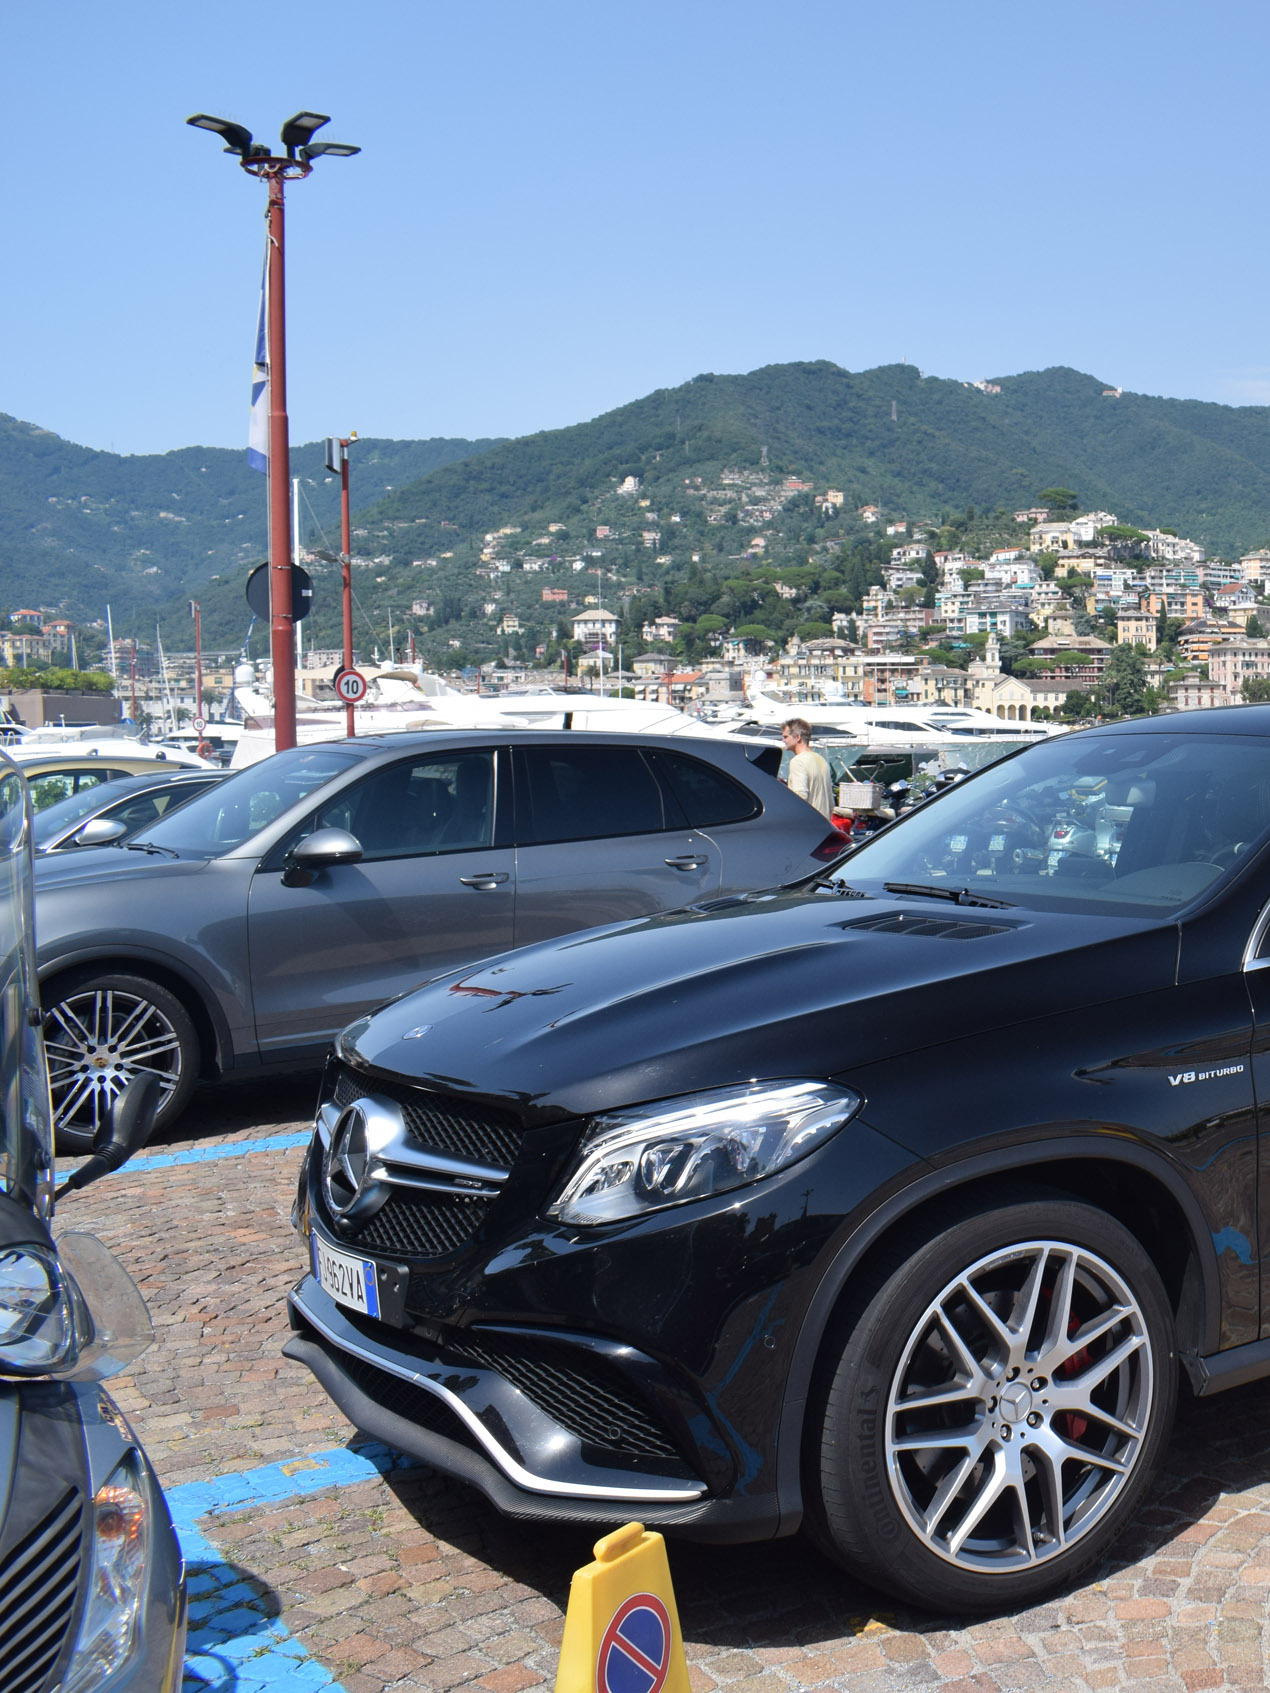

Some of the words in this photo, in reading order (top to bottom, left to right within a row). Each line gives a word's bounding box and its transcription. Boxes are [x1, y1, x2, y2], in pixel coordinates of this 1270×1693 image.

[344, 679, 359, 695] 10
[196, 720, 203, 728] 10
[1167, 1071, 1196, 1087] V8
[1198, 1064, 1244, 1081] BITURBO
